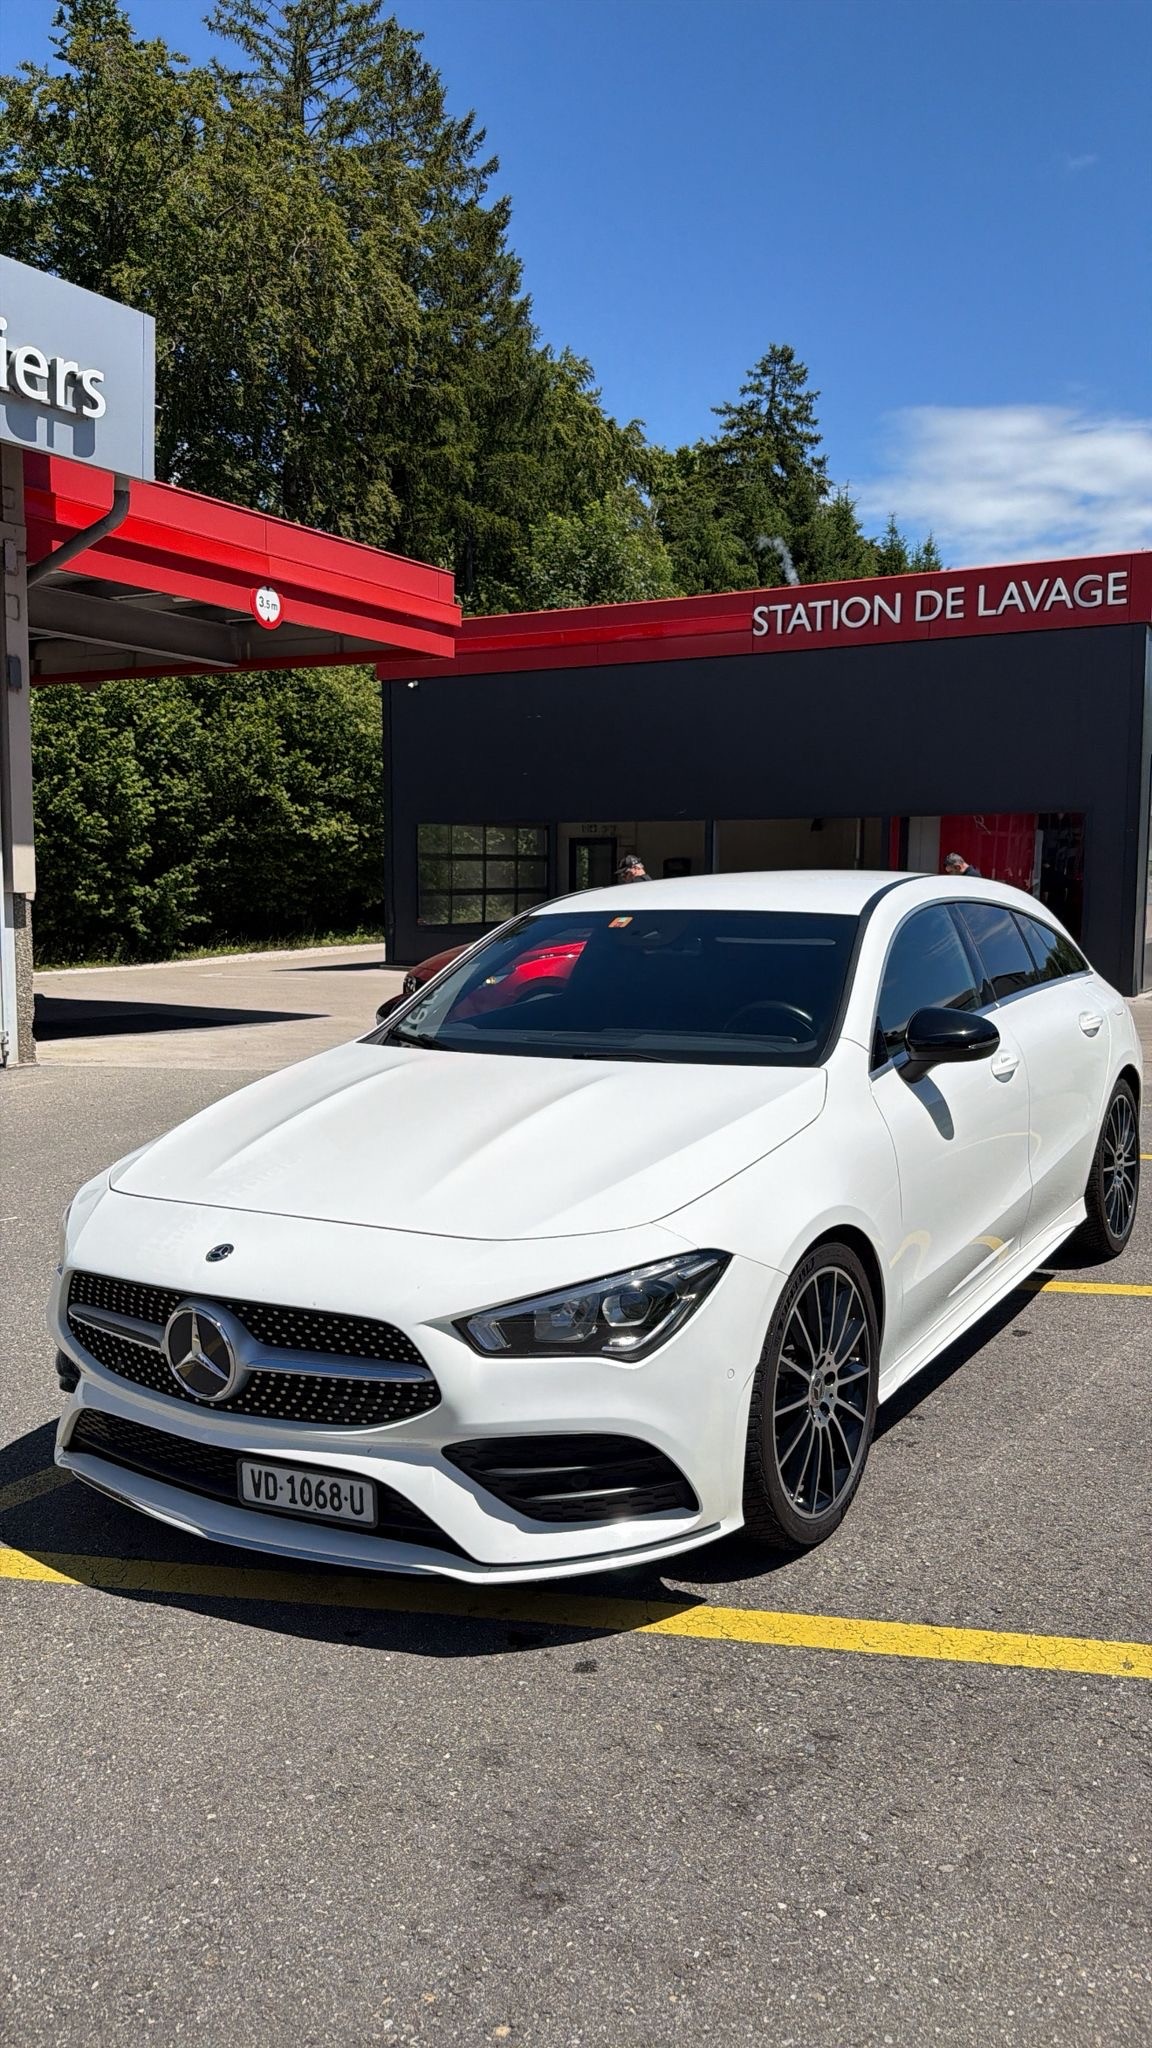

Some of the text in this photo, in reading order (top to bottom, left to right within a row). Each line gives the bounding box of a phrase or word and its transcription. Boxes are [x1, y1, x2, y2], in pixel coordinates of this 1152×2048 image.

[752, 571, 1128, 637] STATION DE LAVAGE
